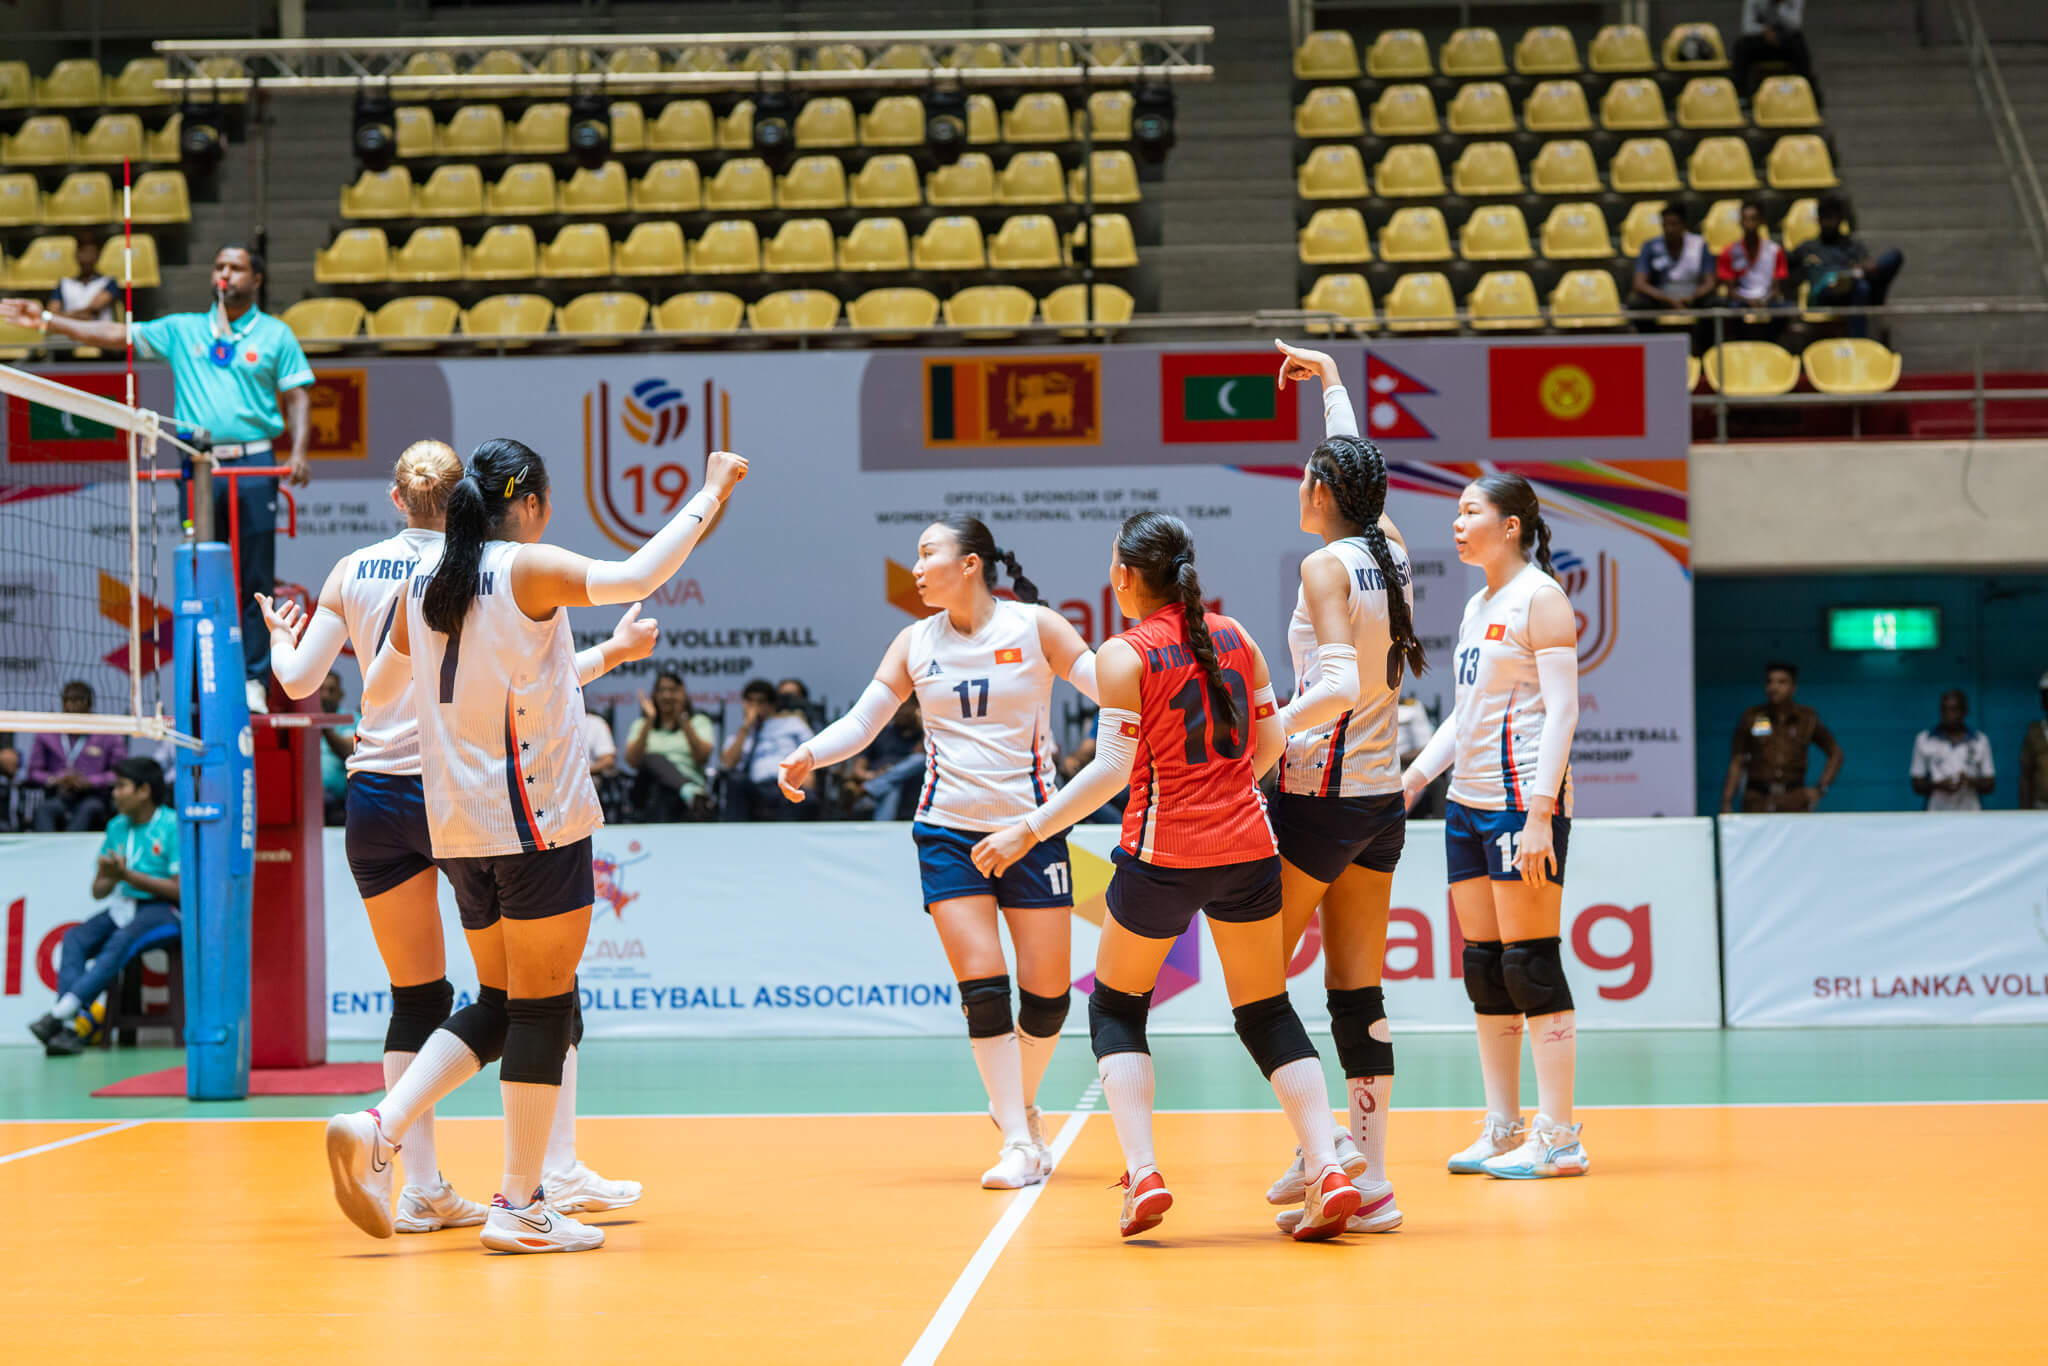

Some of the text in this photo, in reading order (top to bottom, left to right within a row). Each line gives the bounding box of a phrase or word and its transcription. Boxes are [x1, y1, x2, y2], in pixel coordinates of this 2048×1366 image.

[622, 462, 691, 517] 19
[1023, 489, 1098, 505] SPONSOR
[1103, 488, 1124, 503] OF
[1129, 487, 1159, 502] THE
[1185, 503, 1233, 519] TEAM
[356, 558, 416, 581] KYRGY
[665, 626, 818, 649] VOLLEYBALL
[1457, 647, 1480, 686] 13
[953, 677, 990, 719] 17
[1169, 668, 1250, 766] 10
[1043, 861, 1069, 896] 17
[580, 986, 746, 1011] OLLEYBALL
[752, 983, 953, 1010] ASSOCIATION
[1813, 976, 1862, 999] SRI
[1872, 974, 1974, 999] LANKA
